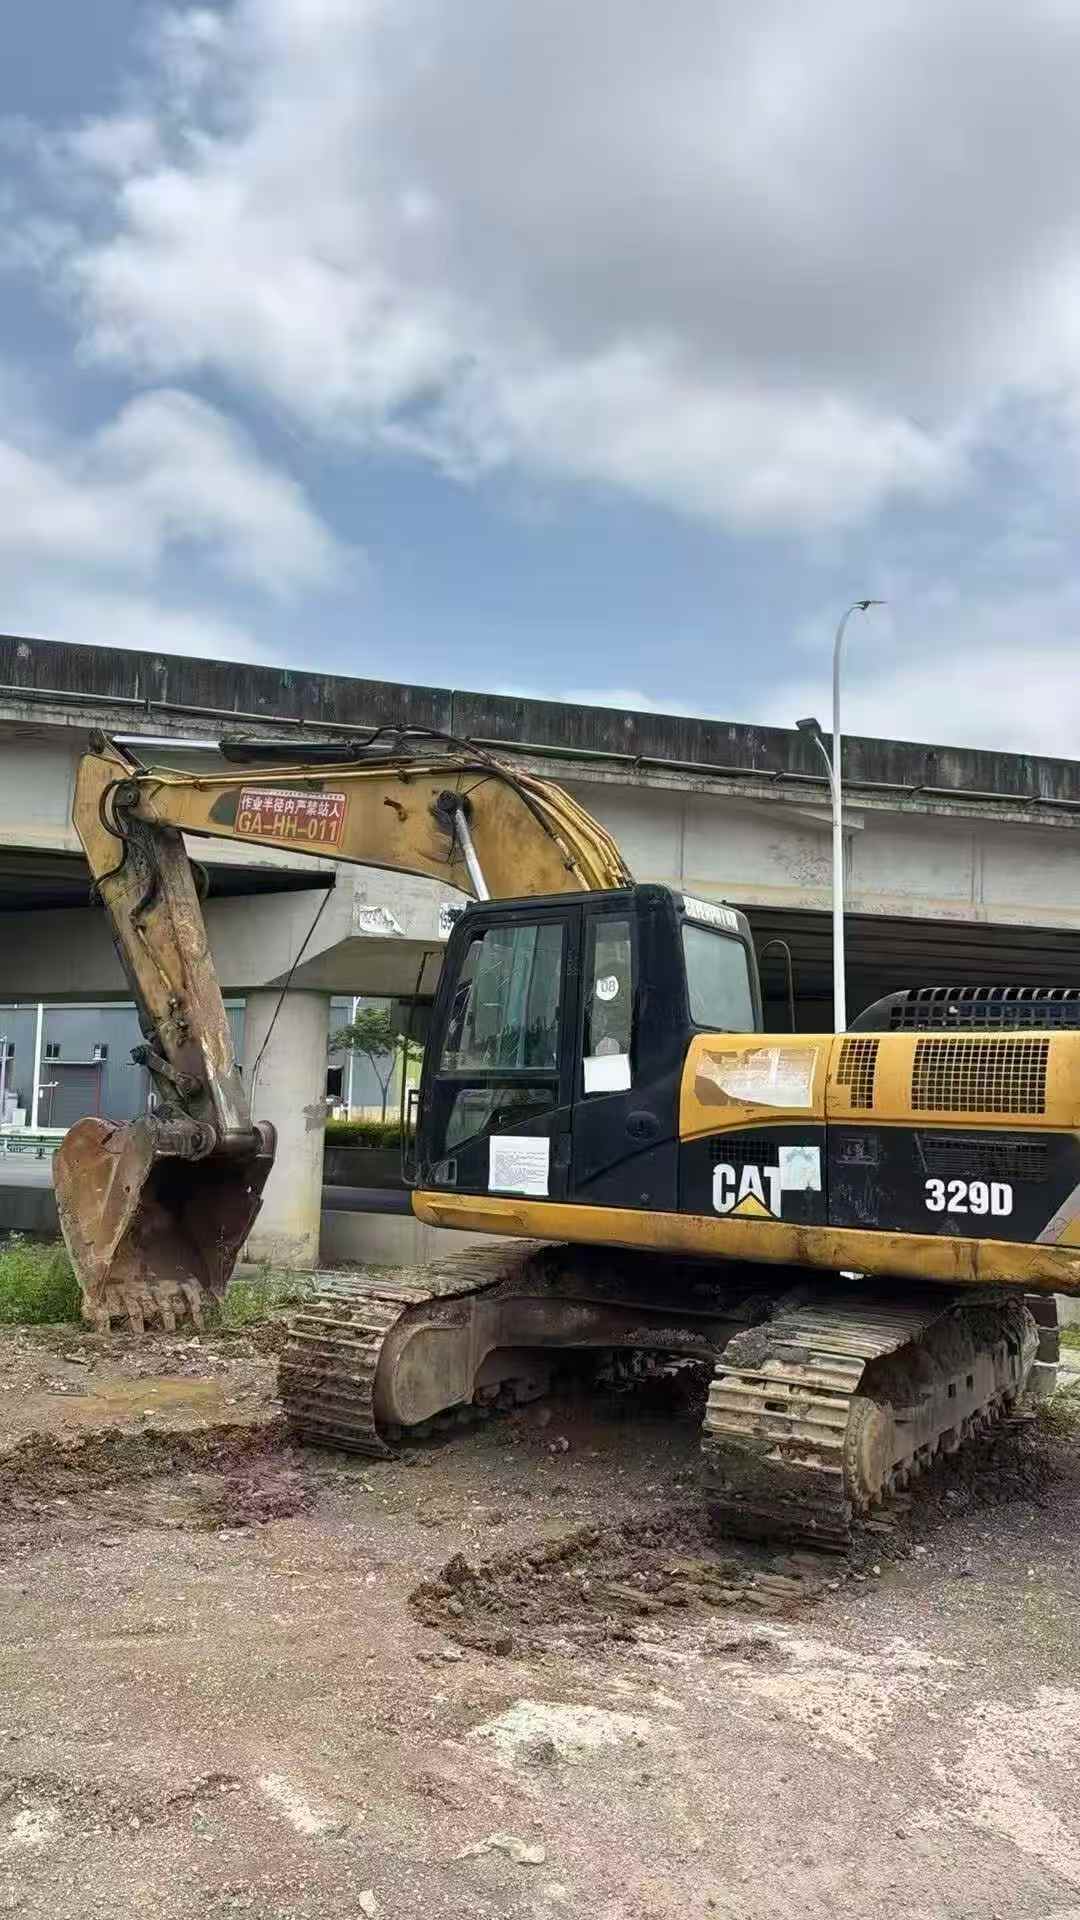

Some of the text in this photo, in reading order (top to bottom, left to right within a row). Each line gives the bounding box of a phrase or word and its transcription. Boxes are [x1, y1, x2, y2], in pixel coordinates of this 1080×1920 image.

[241, 795, 341, 818] 作业半径内严禁站人
[239, 811, 338, 841] GA-HH-011
[712, 1163, 782, 1218] CAT
[924, 1178, 1013, 1216] 329D
